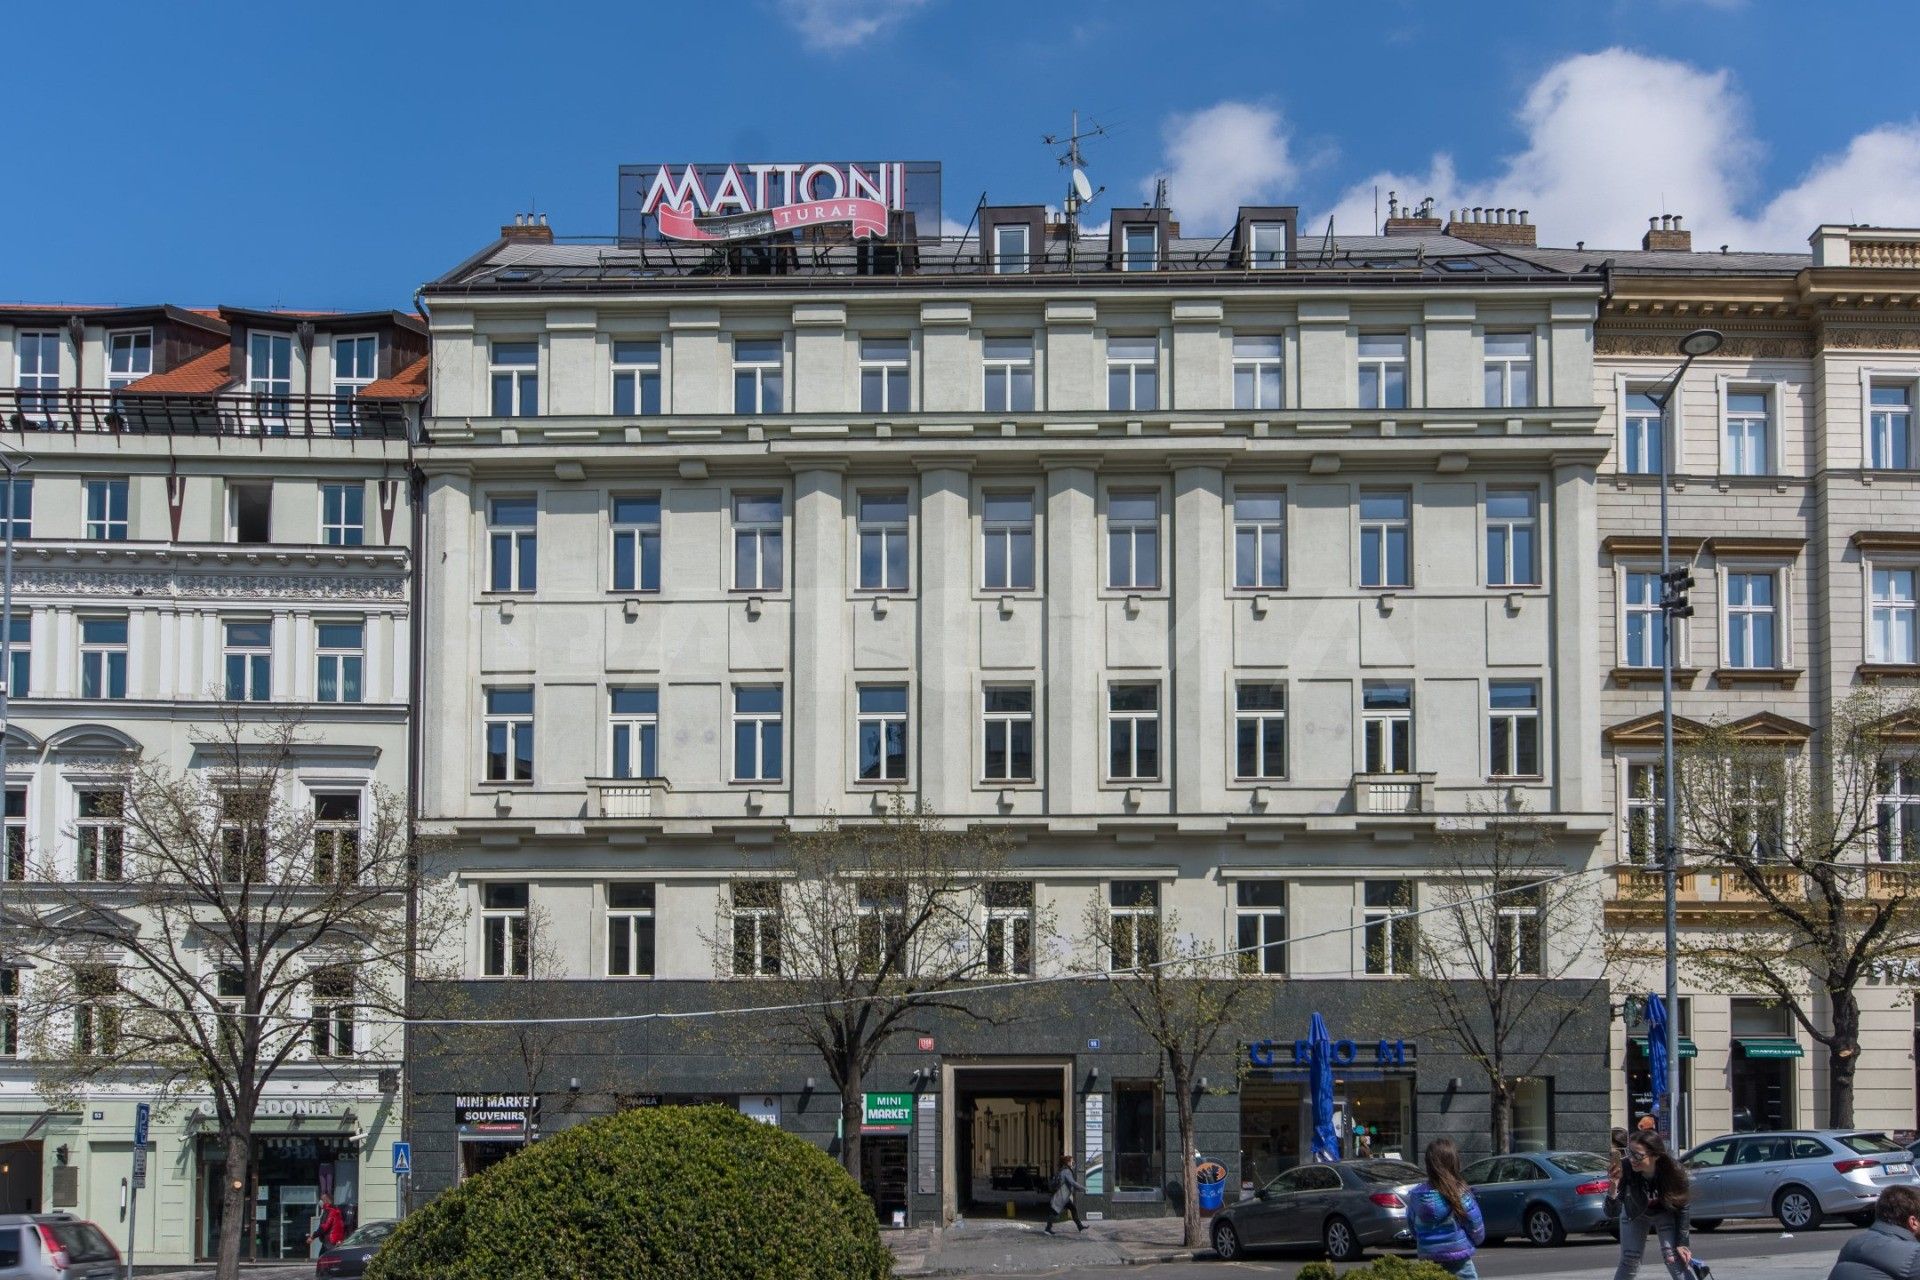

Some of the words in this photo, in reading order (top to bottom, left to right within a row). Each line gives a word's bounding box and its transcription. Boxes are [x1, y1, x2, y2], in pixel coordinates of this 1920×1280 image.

[641, 163, 904, 214] MATTONI
[775, 204, 857, 225] TURAE
[1250, 1040, 1405, 1065] GROM
[201, 1100, 332, 1115] CEDONIA
[456, 1096, 484, 1108] MINI
[487, 1096, 539, 1108] MARKET
[877, 1097, 901, 1105] MINI
[465, 1111, 525, 1121] SOUVENIRS
[868, 1109, 910, 1119] MARKET
